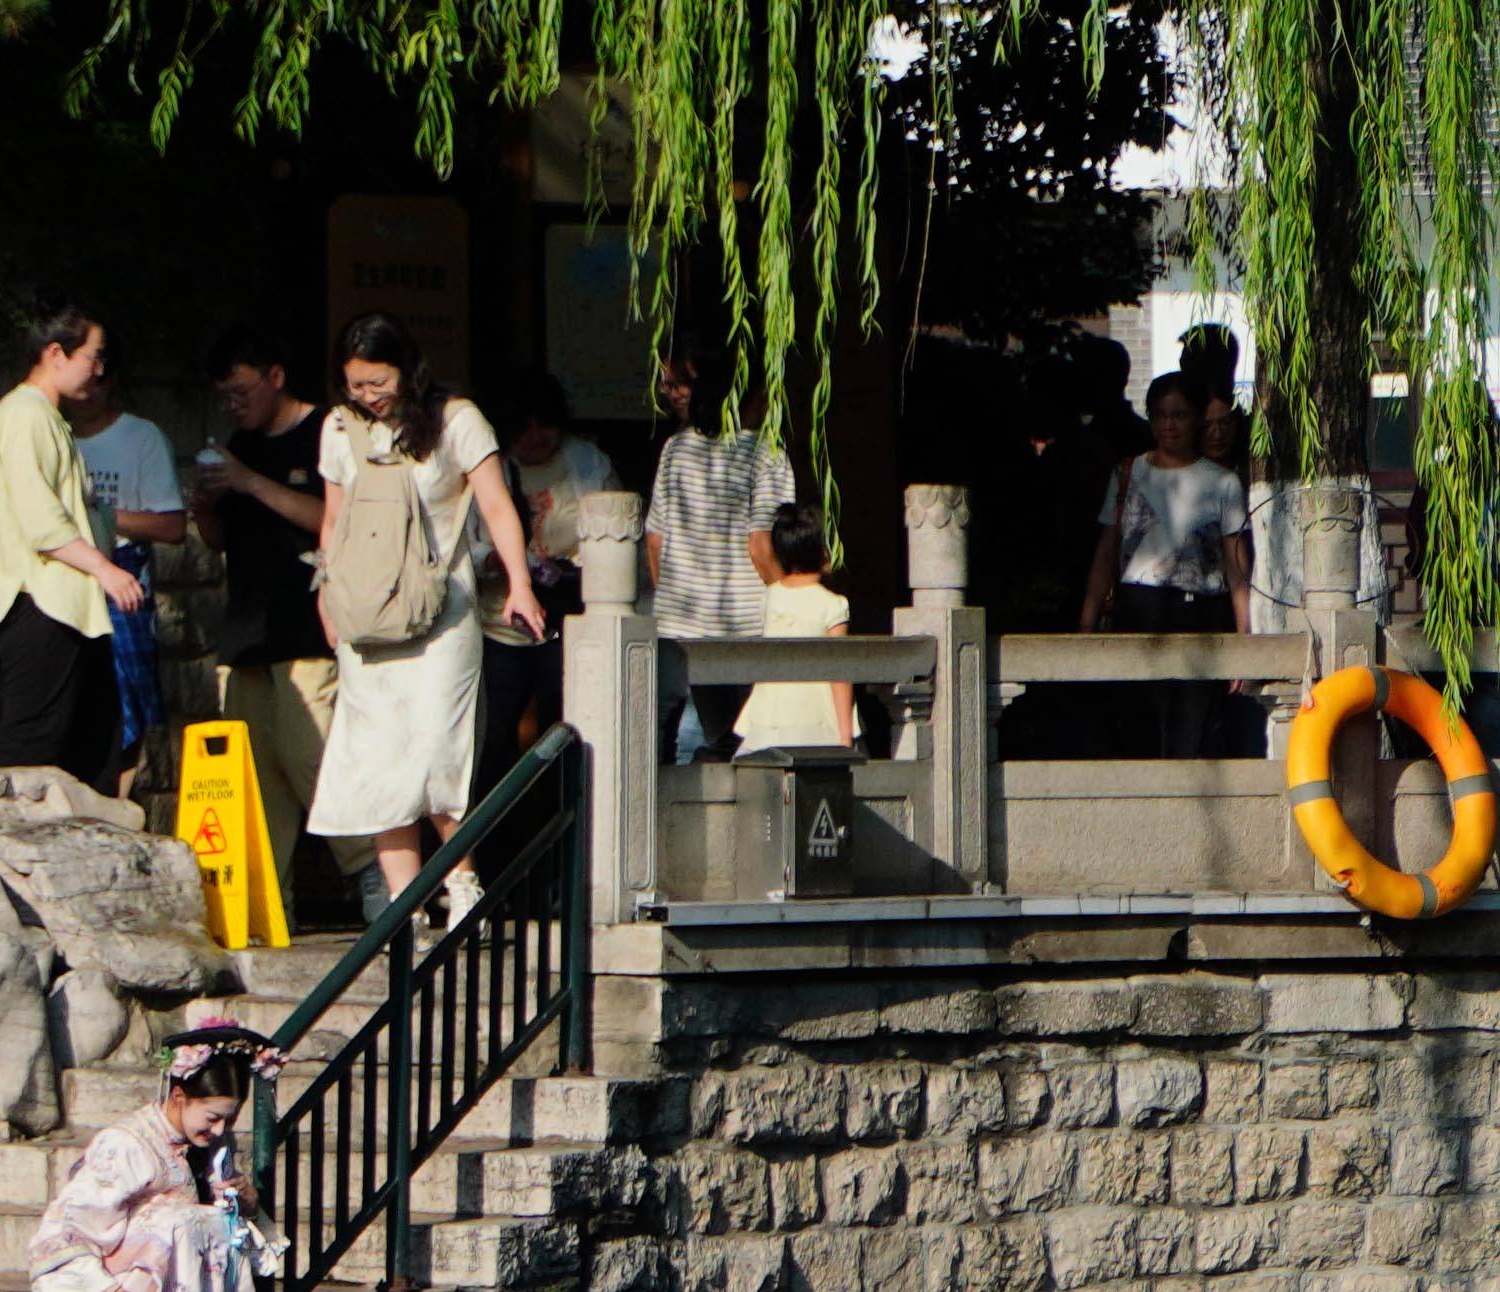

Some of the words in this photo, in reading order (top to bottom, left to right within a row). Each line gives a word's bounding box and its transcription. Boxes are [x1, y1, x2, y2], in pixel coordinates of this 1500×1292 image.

[192, 779, 230, 791] CAUTION
[187, 791, 205, 802] WET
[207, 789, 234, 800] FLOOR
